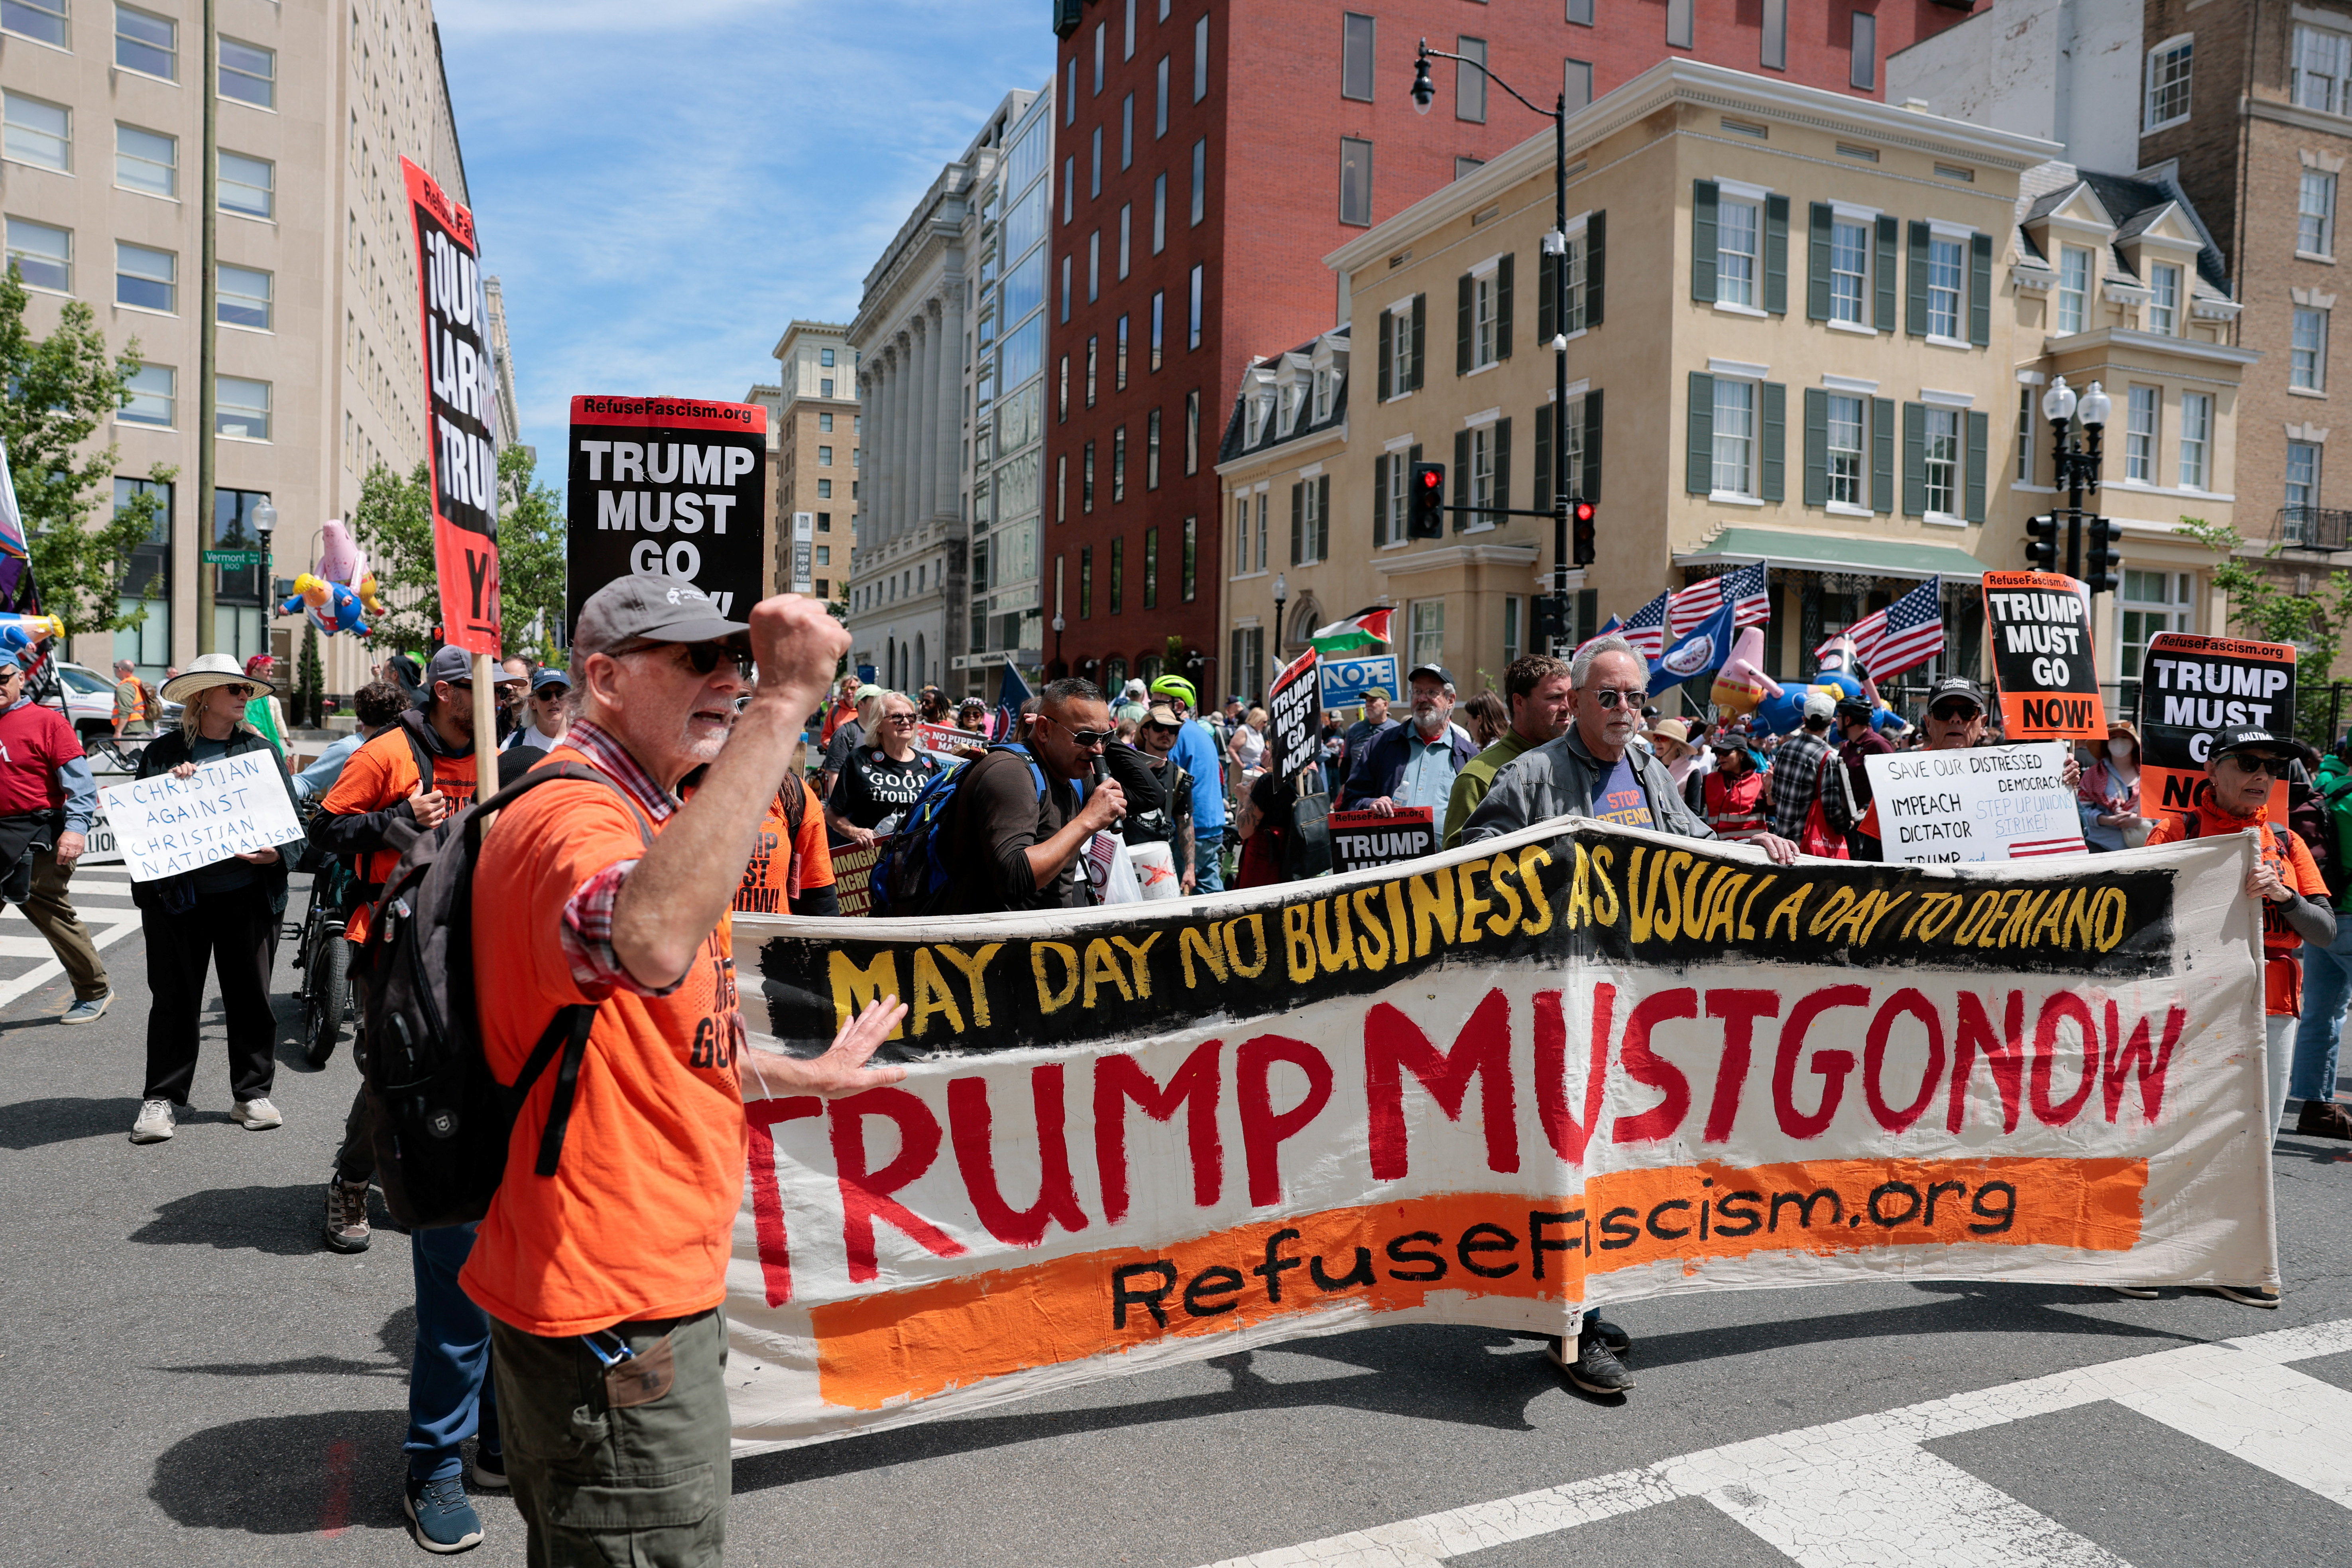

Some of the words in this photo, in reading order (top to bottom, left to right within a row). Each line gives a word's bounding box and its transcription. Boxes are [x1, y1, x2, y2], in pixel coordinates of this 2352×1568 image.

[584, 398, 752, 424] RefuseFascism.org
[580, 440, 755, 486] TRUMP
[598, 490, 736, 534] MUST
[206, 552, 245, 562] Vermont
[630, 539, 701, 582] GO
[1989, 575, 2075, 590] RefuseFascism.org
[1989, 593, 2083, 624] TRUMP
[2006, 625, 2079, 655] MUST
[2159, 635, 2284, 659] RefuseFascism.org
[1323, 660, 1391, 690] NOPE
[2032, 657, 2070, 687] GO
[2153, 659, 2288, 698] TRUMP
[1272, 669, 1316, 718] TRUMP
[1277, 693, 1313, 738] MUST
[2023, 698, 2094, 729] NOW!
[2164, 695, 2272, 729] MUST
[932, 731, 947, 741] NO
[1287, 722, 1306, 750] GO
[2189, 732, 2215, 763] G
[1282, 734, 1315, 778] NOW!
[1888, 760, 1929, 780] SAVE
[1934, 758, 1965, 777] OUR
[1970, 754, 2042, 774] DISTRESSED
[109, 793, 126, 811] A
[133, 758, 260, 803] CHRISTIAN
[1607, 790, 1640, 809] STOP
[1998, 775, 2061, 793] DEMOCRACY
[147, 788, 248, 827] AGAINST
[1892, 793, 1962, 816] IMPEACH
[1976, 798, 2012, 820] STEP
[2033, 793, 2073, 813] UNIONS
[131, 816, 255, 856] CHRISTIAN
[1336, 831, 1429, 858] TRUMP
[1900, 820, 1972, 843] DICTATOR
[142, 826, 301, 877] NATIONALISM
[837, 891, 871, 915] BUILT
[828, 942, 1006, 1041] MAY
[1030, 931, 1163, 1015] DAY
[1178, 913, 1267, 989] NO
[1282, 844, 1554, 984] BUSINESS
[1566, 842, 1620, 930] AS
[1629, 846, 1778, 944] USUAL
[1765, 881, 1814, 941] A
[1808, 885, 1912, 948] DAY
[1900, 889, 1964, 945] TO
[1953, 886, 2128, 953] DEMAND
[744, 1033, 1335, 1308] TRUMP
[1363, 981, 1782, 1181] MUST
[1772, 984, 1945, 1140] GO
[1946, 989, 2187, 1135] NOW
[1111, 1177, 2016, 1330] RefuseFscism.org
